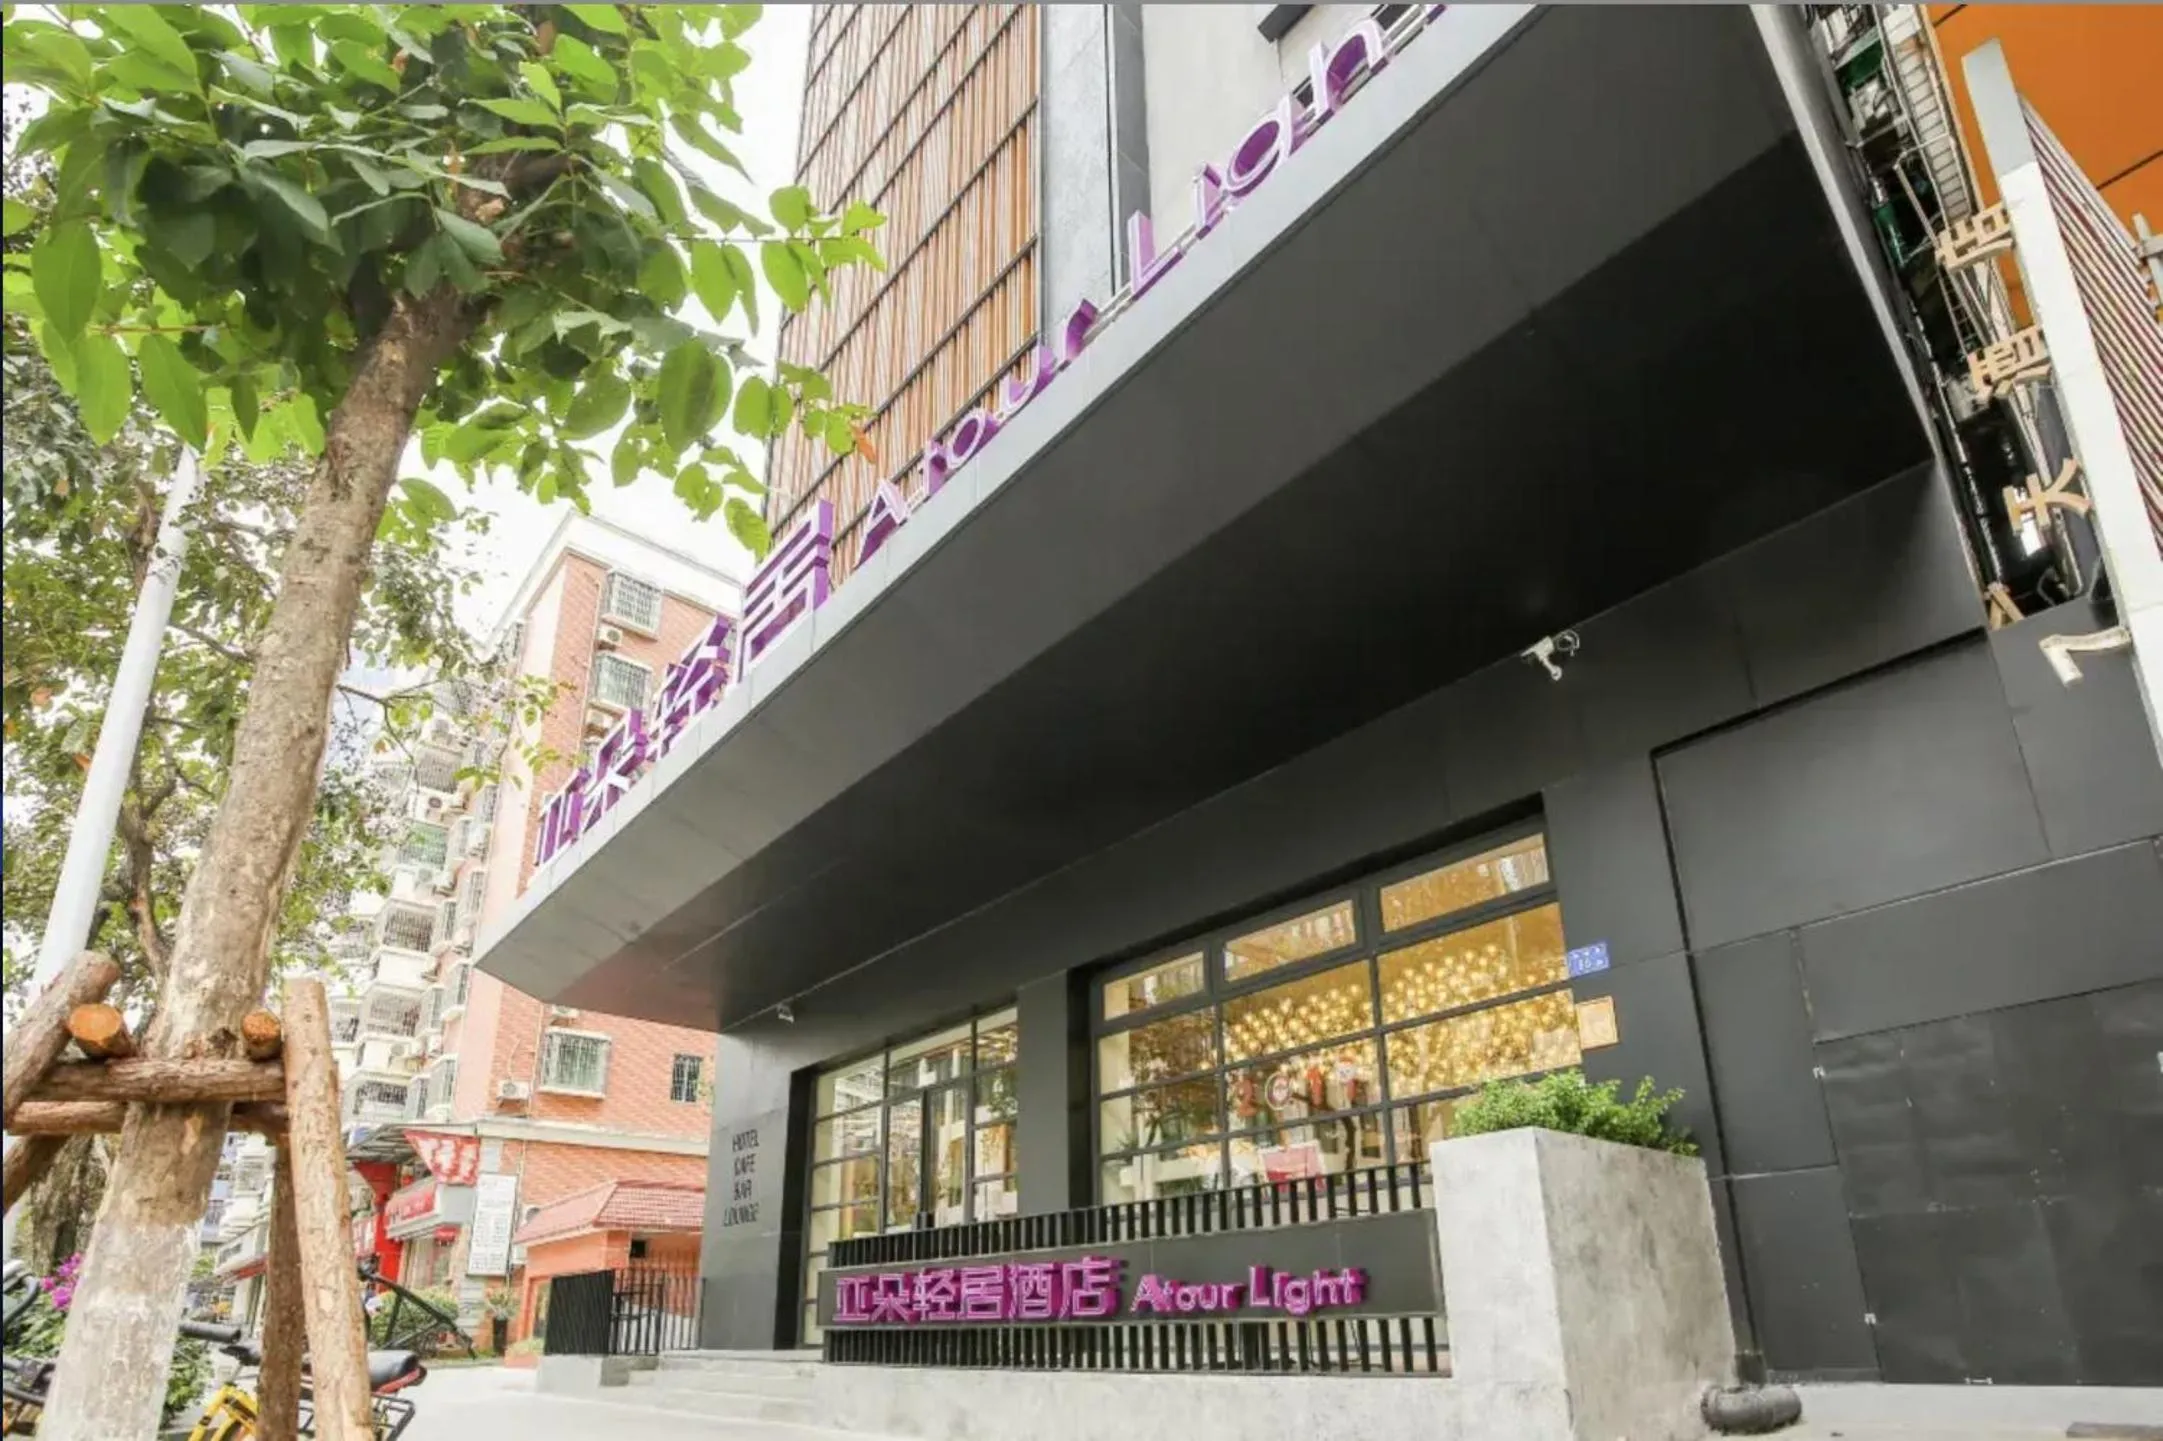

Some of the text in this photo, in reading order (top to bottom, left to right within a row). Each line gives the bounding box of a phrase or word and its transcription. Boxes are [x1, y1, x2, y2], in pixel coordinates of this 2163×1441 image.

[832, 1256, 1369, 1323] 亚朵轻居酒店 Atour Light
